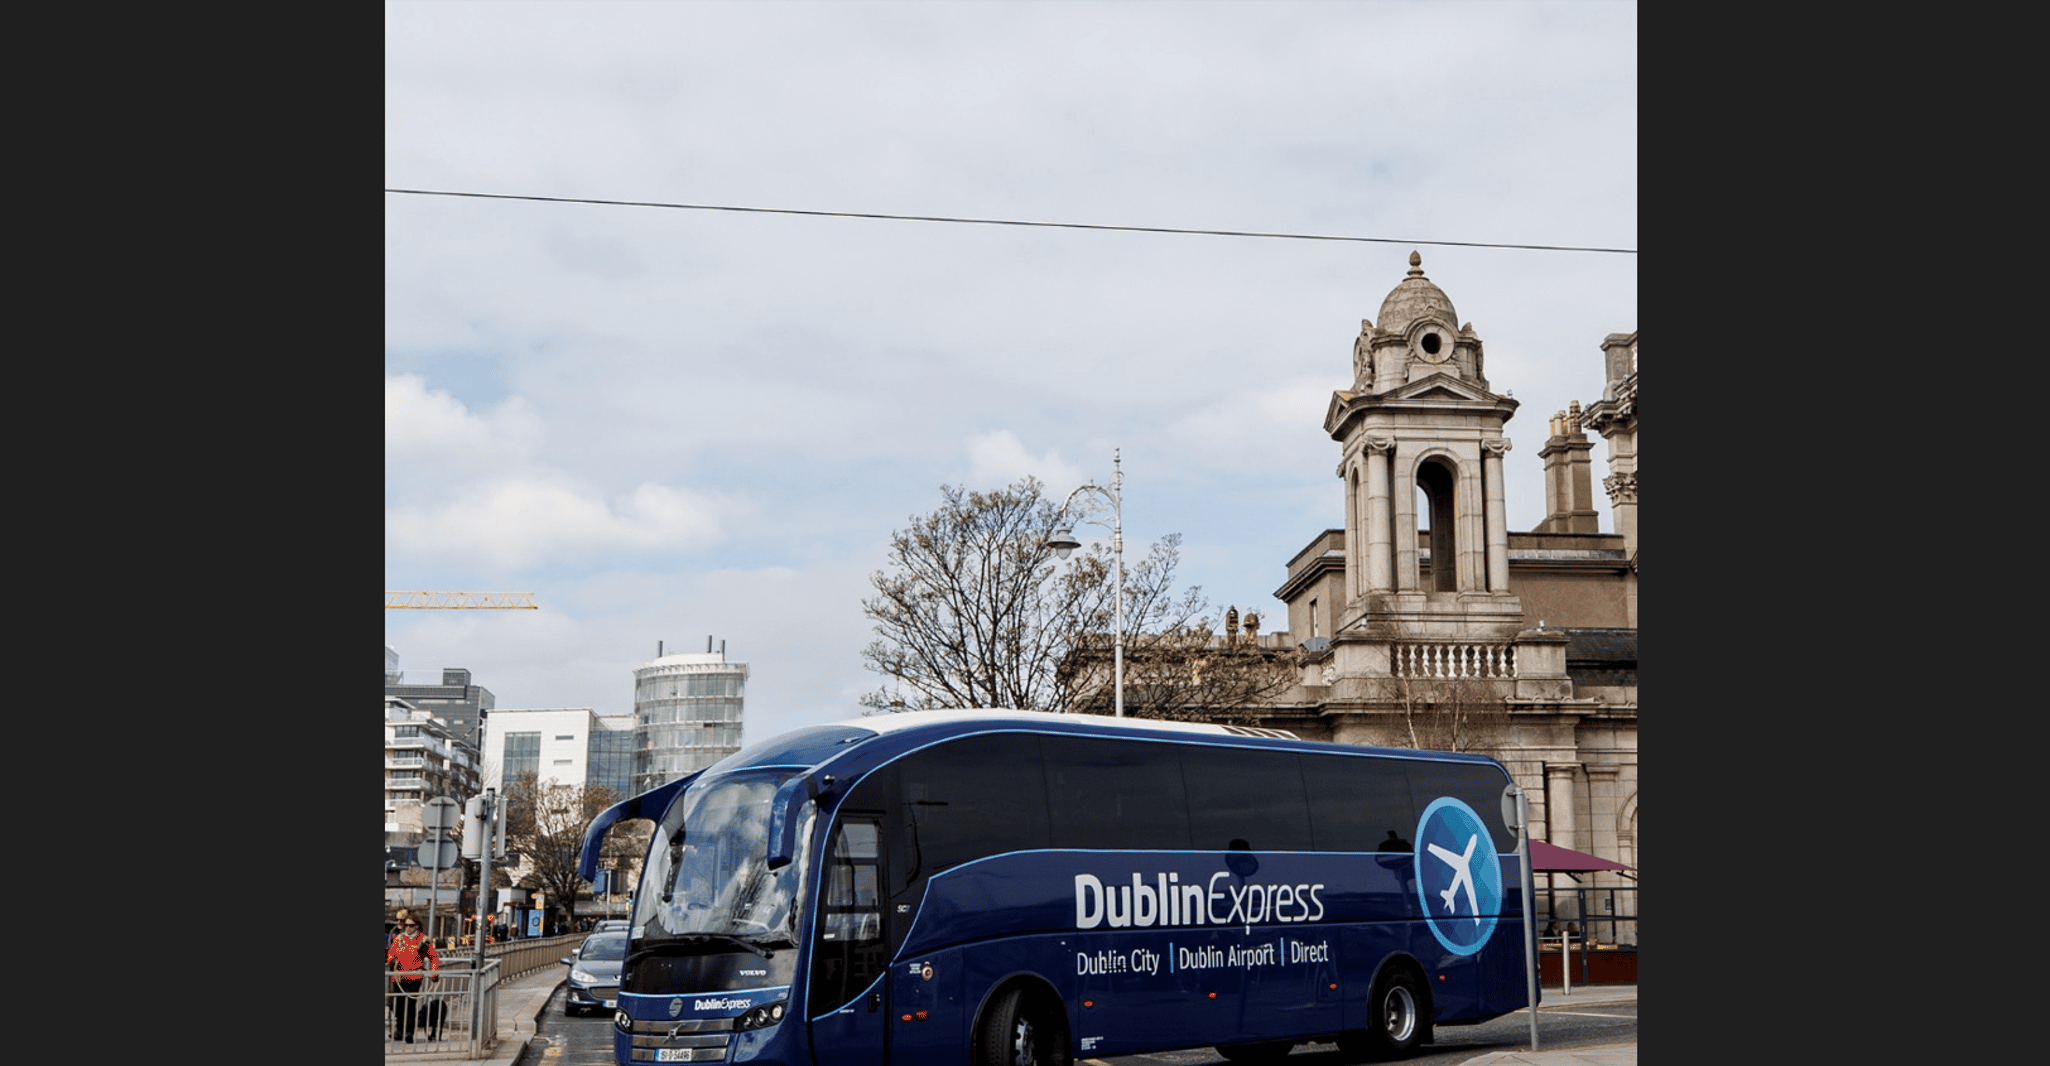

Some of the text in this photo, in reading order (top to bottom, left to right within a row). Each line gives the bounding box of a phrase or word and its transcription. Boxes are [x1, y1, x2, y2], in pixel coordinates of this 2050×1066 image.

[1074, 871, 1325, 936] DublinExpress
[1077, 948, 1160, 976] Dublin City
[1179, 943, 1275, 971] Dublin Airport
[1290, 940, 1329, 964] Direct
[694, 998, 751, 1011] DublinExpress
